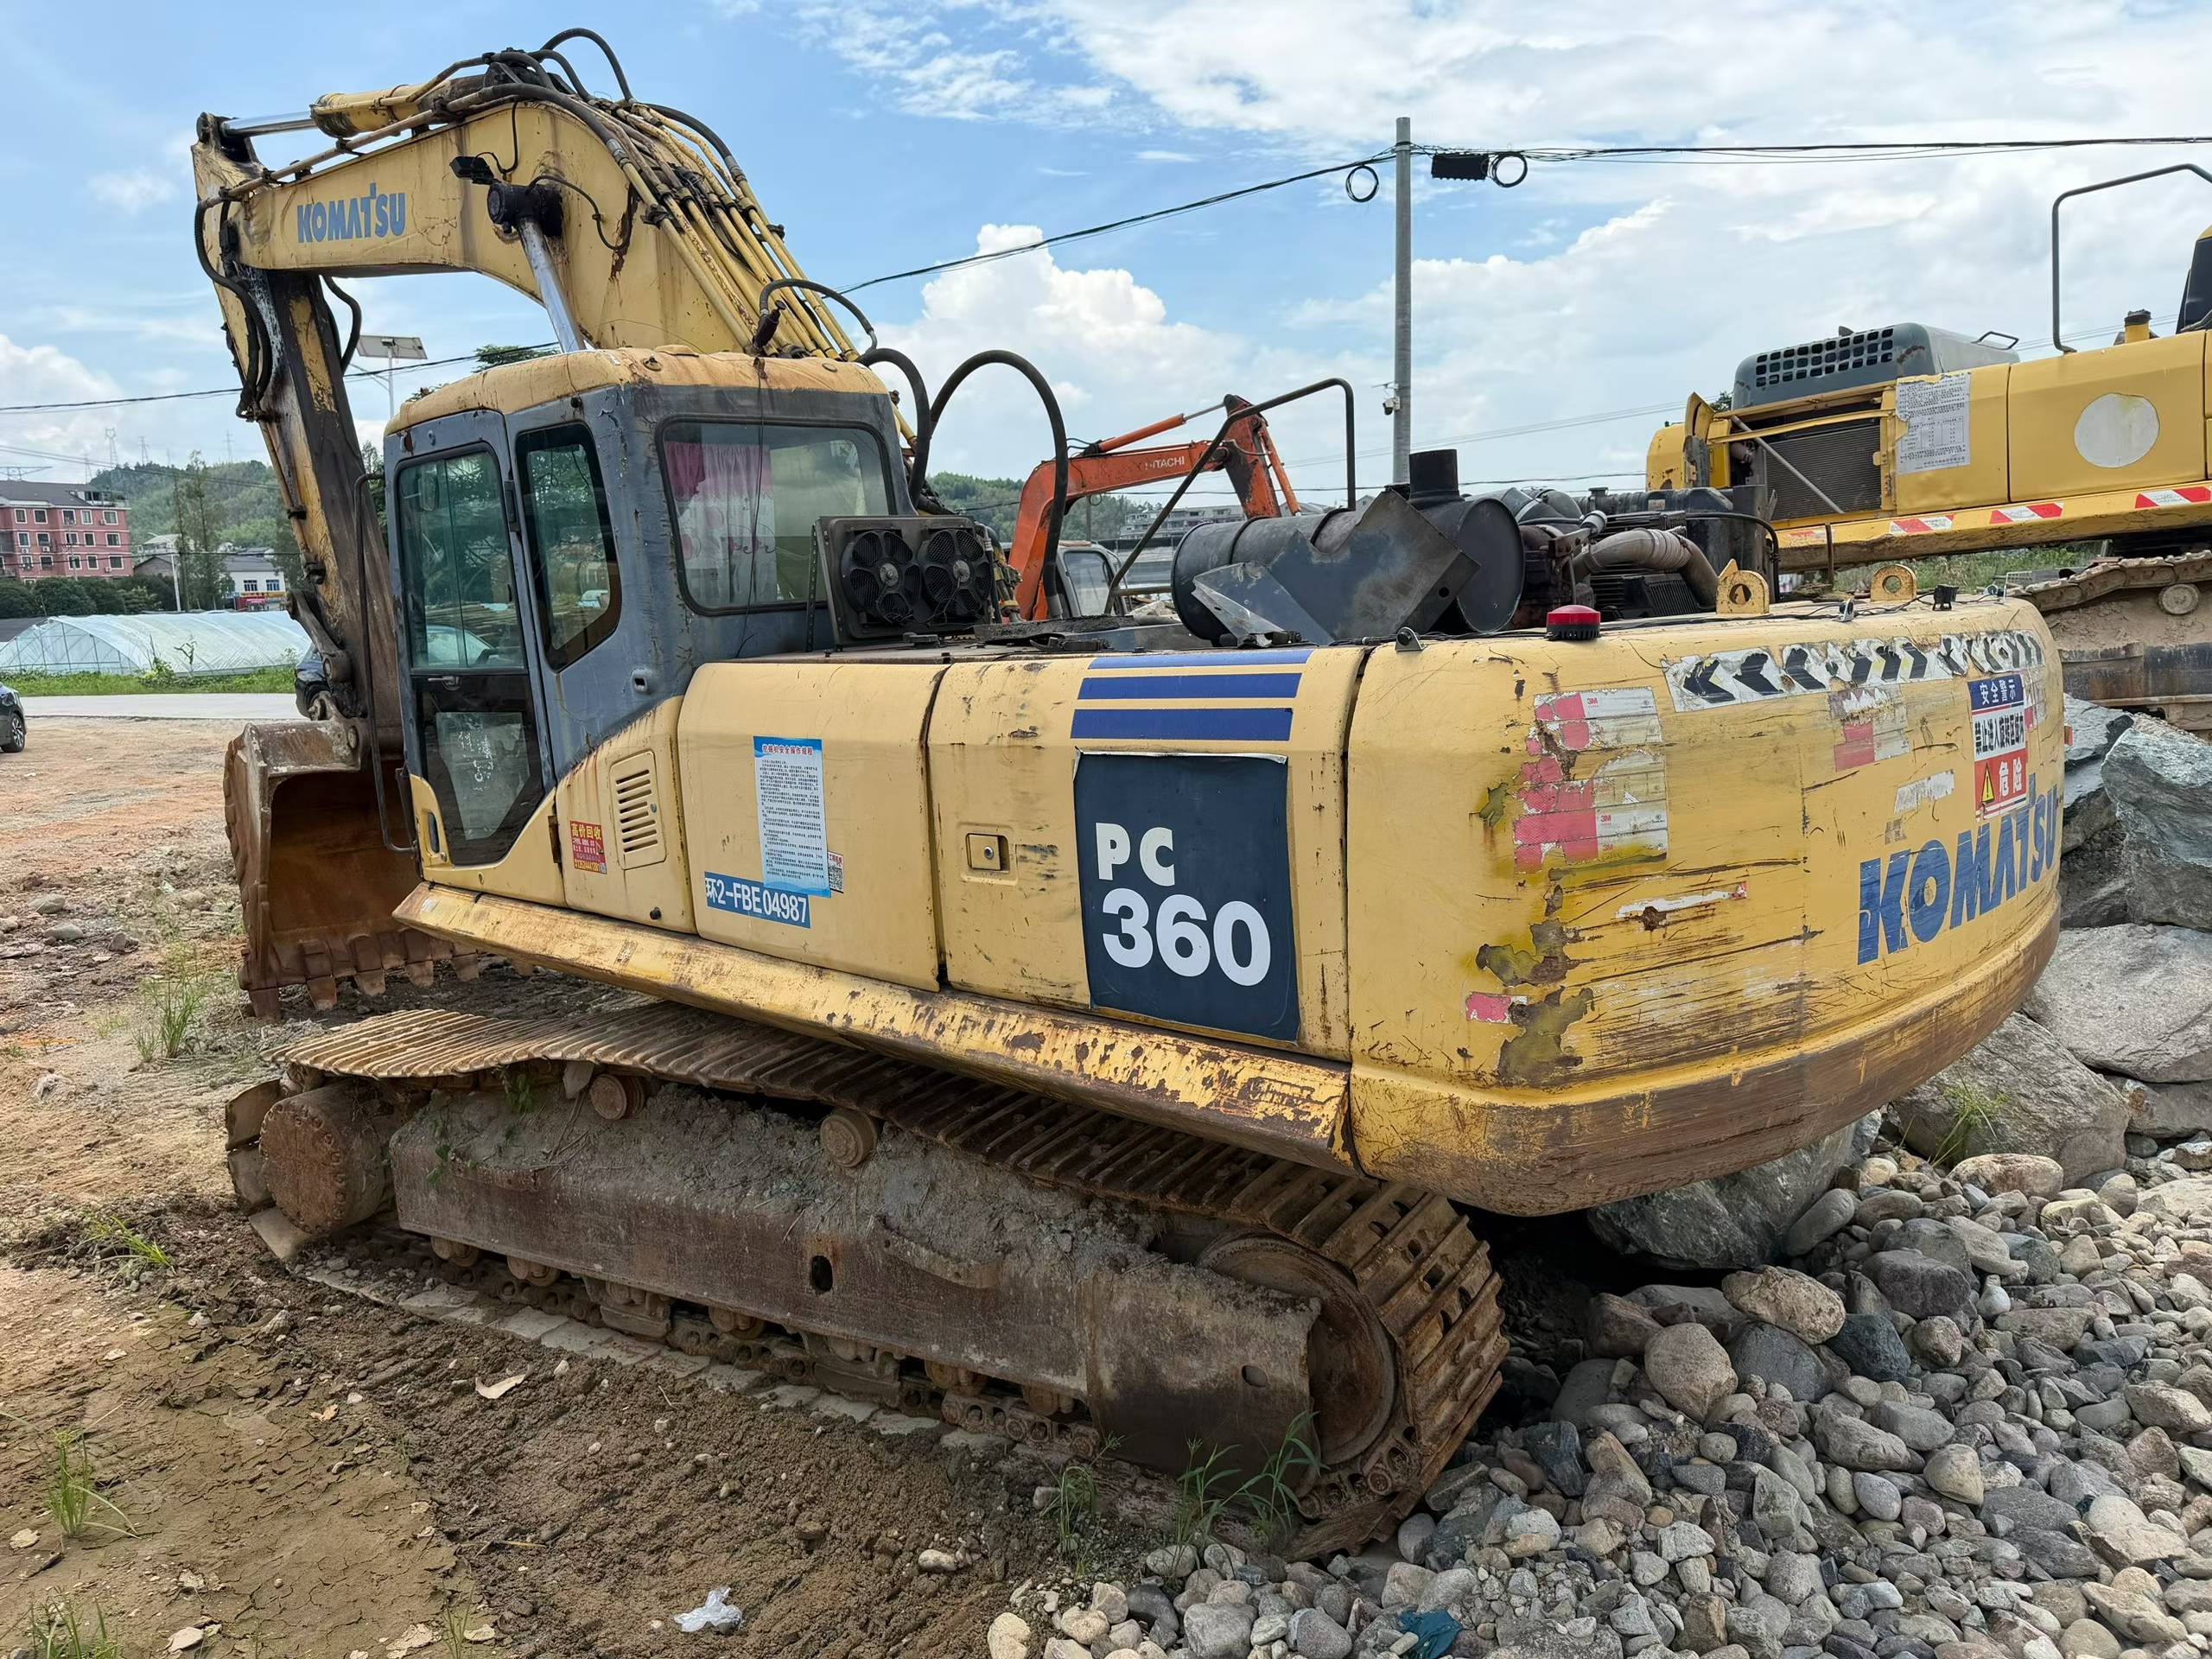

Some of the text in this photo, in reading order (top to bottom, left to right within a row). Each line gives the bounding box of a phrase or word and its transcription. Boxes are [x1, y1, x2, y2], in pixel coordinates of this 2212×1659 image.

[296, 182, 406, 244] KOMATSU
[1979, 679, 2016, 705] 安全警示
[1975, 711, 2024, 755] 禁止进入旋转区域内
[1999, 757, 2023, 798] 危险
[571, 823, 602, 840] 高价回收
[1096, 823, 1175, 887] PC
[1857, 772, 2059, 965] KOMATSU
[1103, 888, 1271, 986] 360
